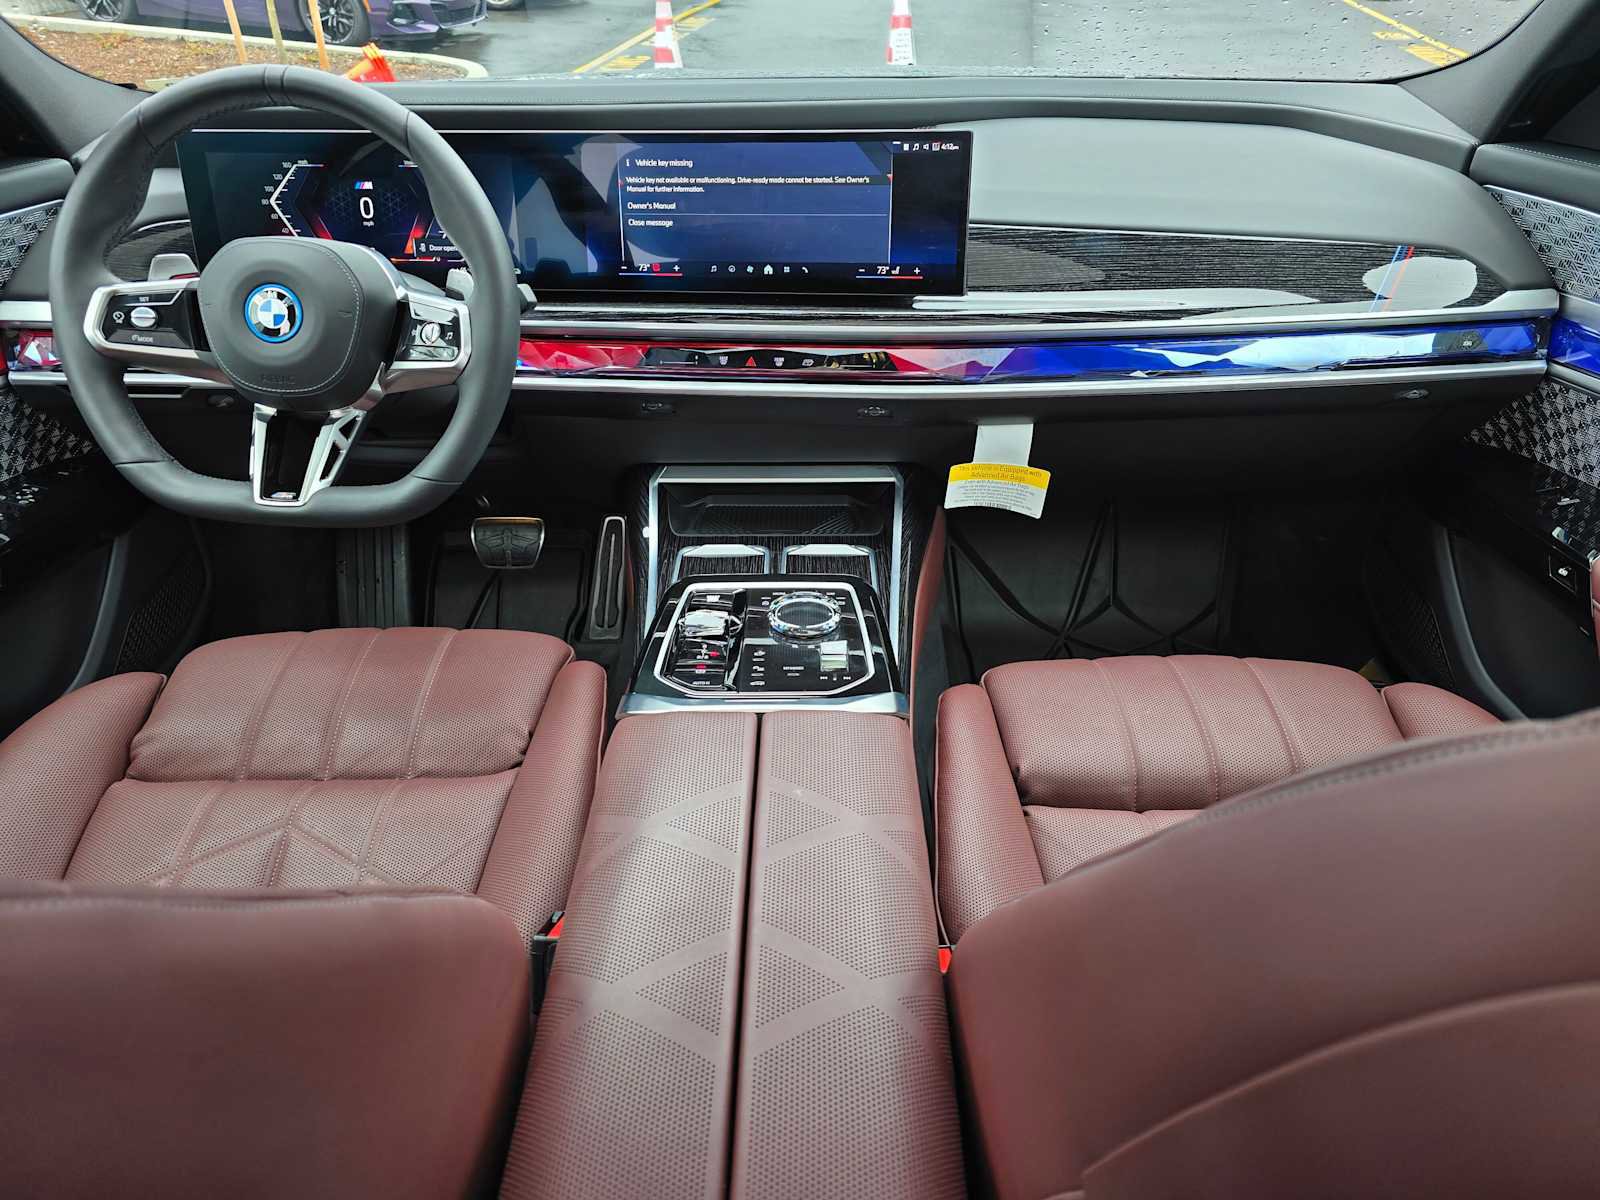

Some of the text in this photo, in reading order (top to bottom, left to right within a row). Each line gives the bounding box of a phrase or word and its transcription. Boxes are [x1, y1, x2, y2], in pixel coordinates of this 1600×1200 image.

[635, 159, 693, 168] Vehicle key missing
[272, 173, 283, 181] 120
[625, 176, 646, 184] Vehicle
[646, 176, 656, 185] key
[666, 176, 690, 184] available
[769, 176, 785, 184] mode
[785, 176, 804, 184] cannot
[805, 176, 813, 184] be
[813, 176, 834, 184] started.
[834, 176, 846, 184] See
[846, 176, 870, 184] Owner's
[626, 185, 705, 193] Manual for further information.
[359, 196, 374, 219] 0
[627, 201, 677, 210] Owner's Manual
[628, 218, 674, 228] Close message
